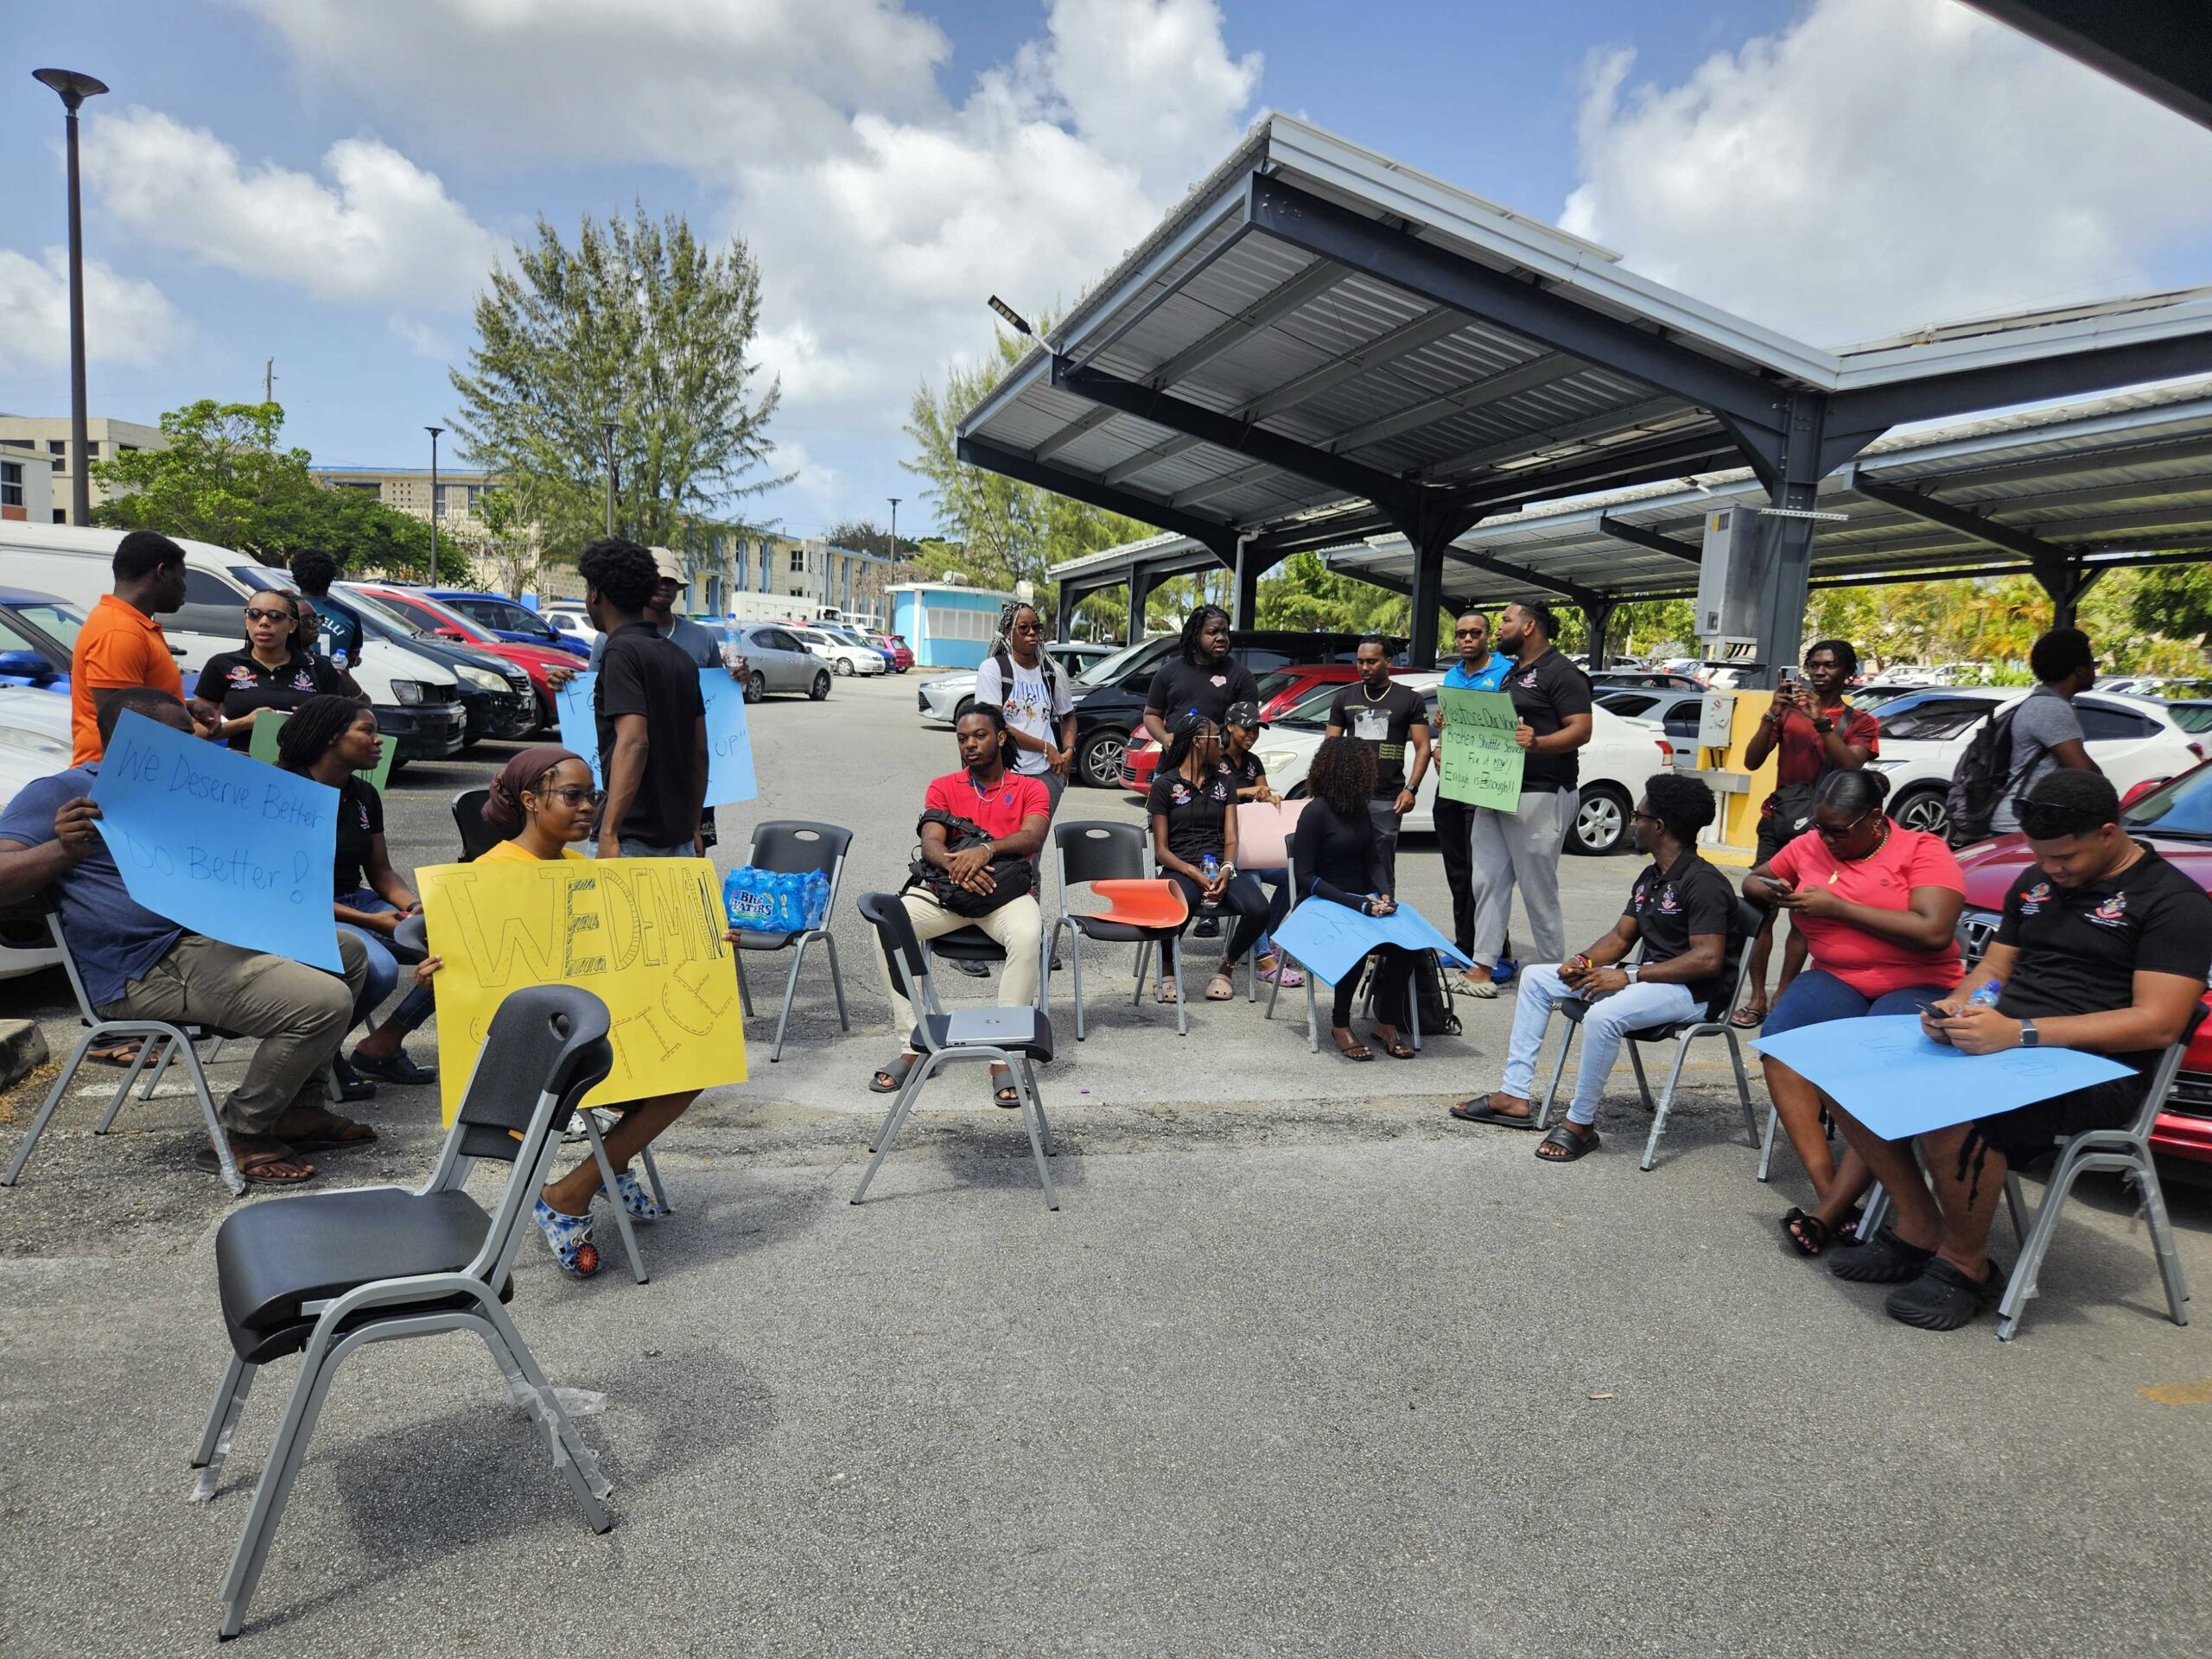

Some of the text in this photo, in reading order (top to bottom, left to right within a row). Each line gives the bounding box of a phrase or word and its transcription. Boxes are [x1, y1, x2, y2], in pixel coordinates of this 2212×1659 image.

[1446, 724, 1475, 747] Broken
[1478, 734, 1501, 751] Shuttle
[1445, 762, 1470, 789] Enough
[1473, 776, 1480, 785] is
[1468, 752, 1480, 765] Fix
[1483, 755, 1490, 766] it
[118, 739, 325, 828] We Deserve Better
[124, 830, 175, 876] Do
[432, 867, 607, 988] WE
